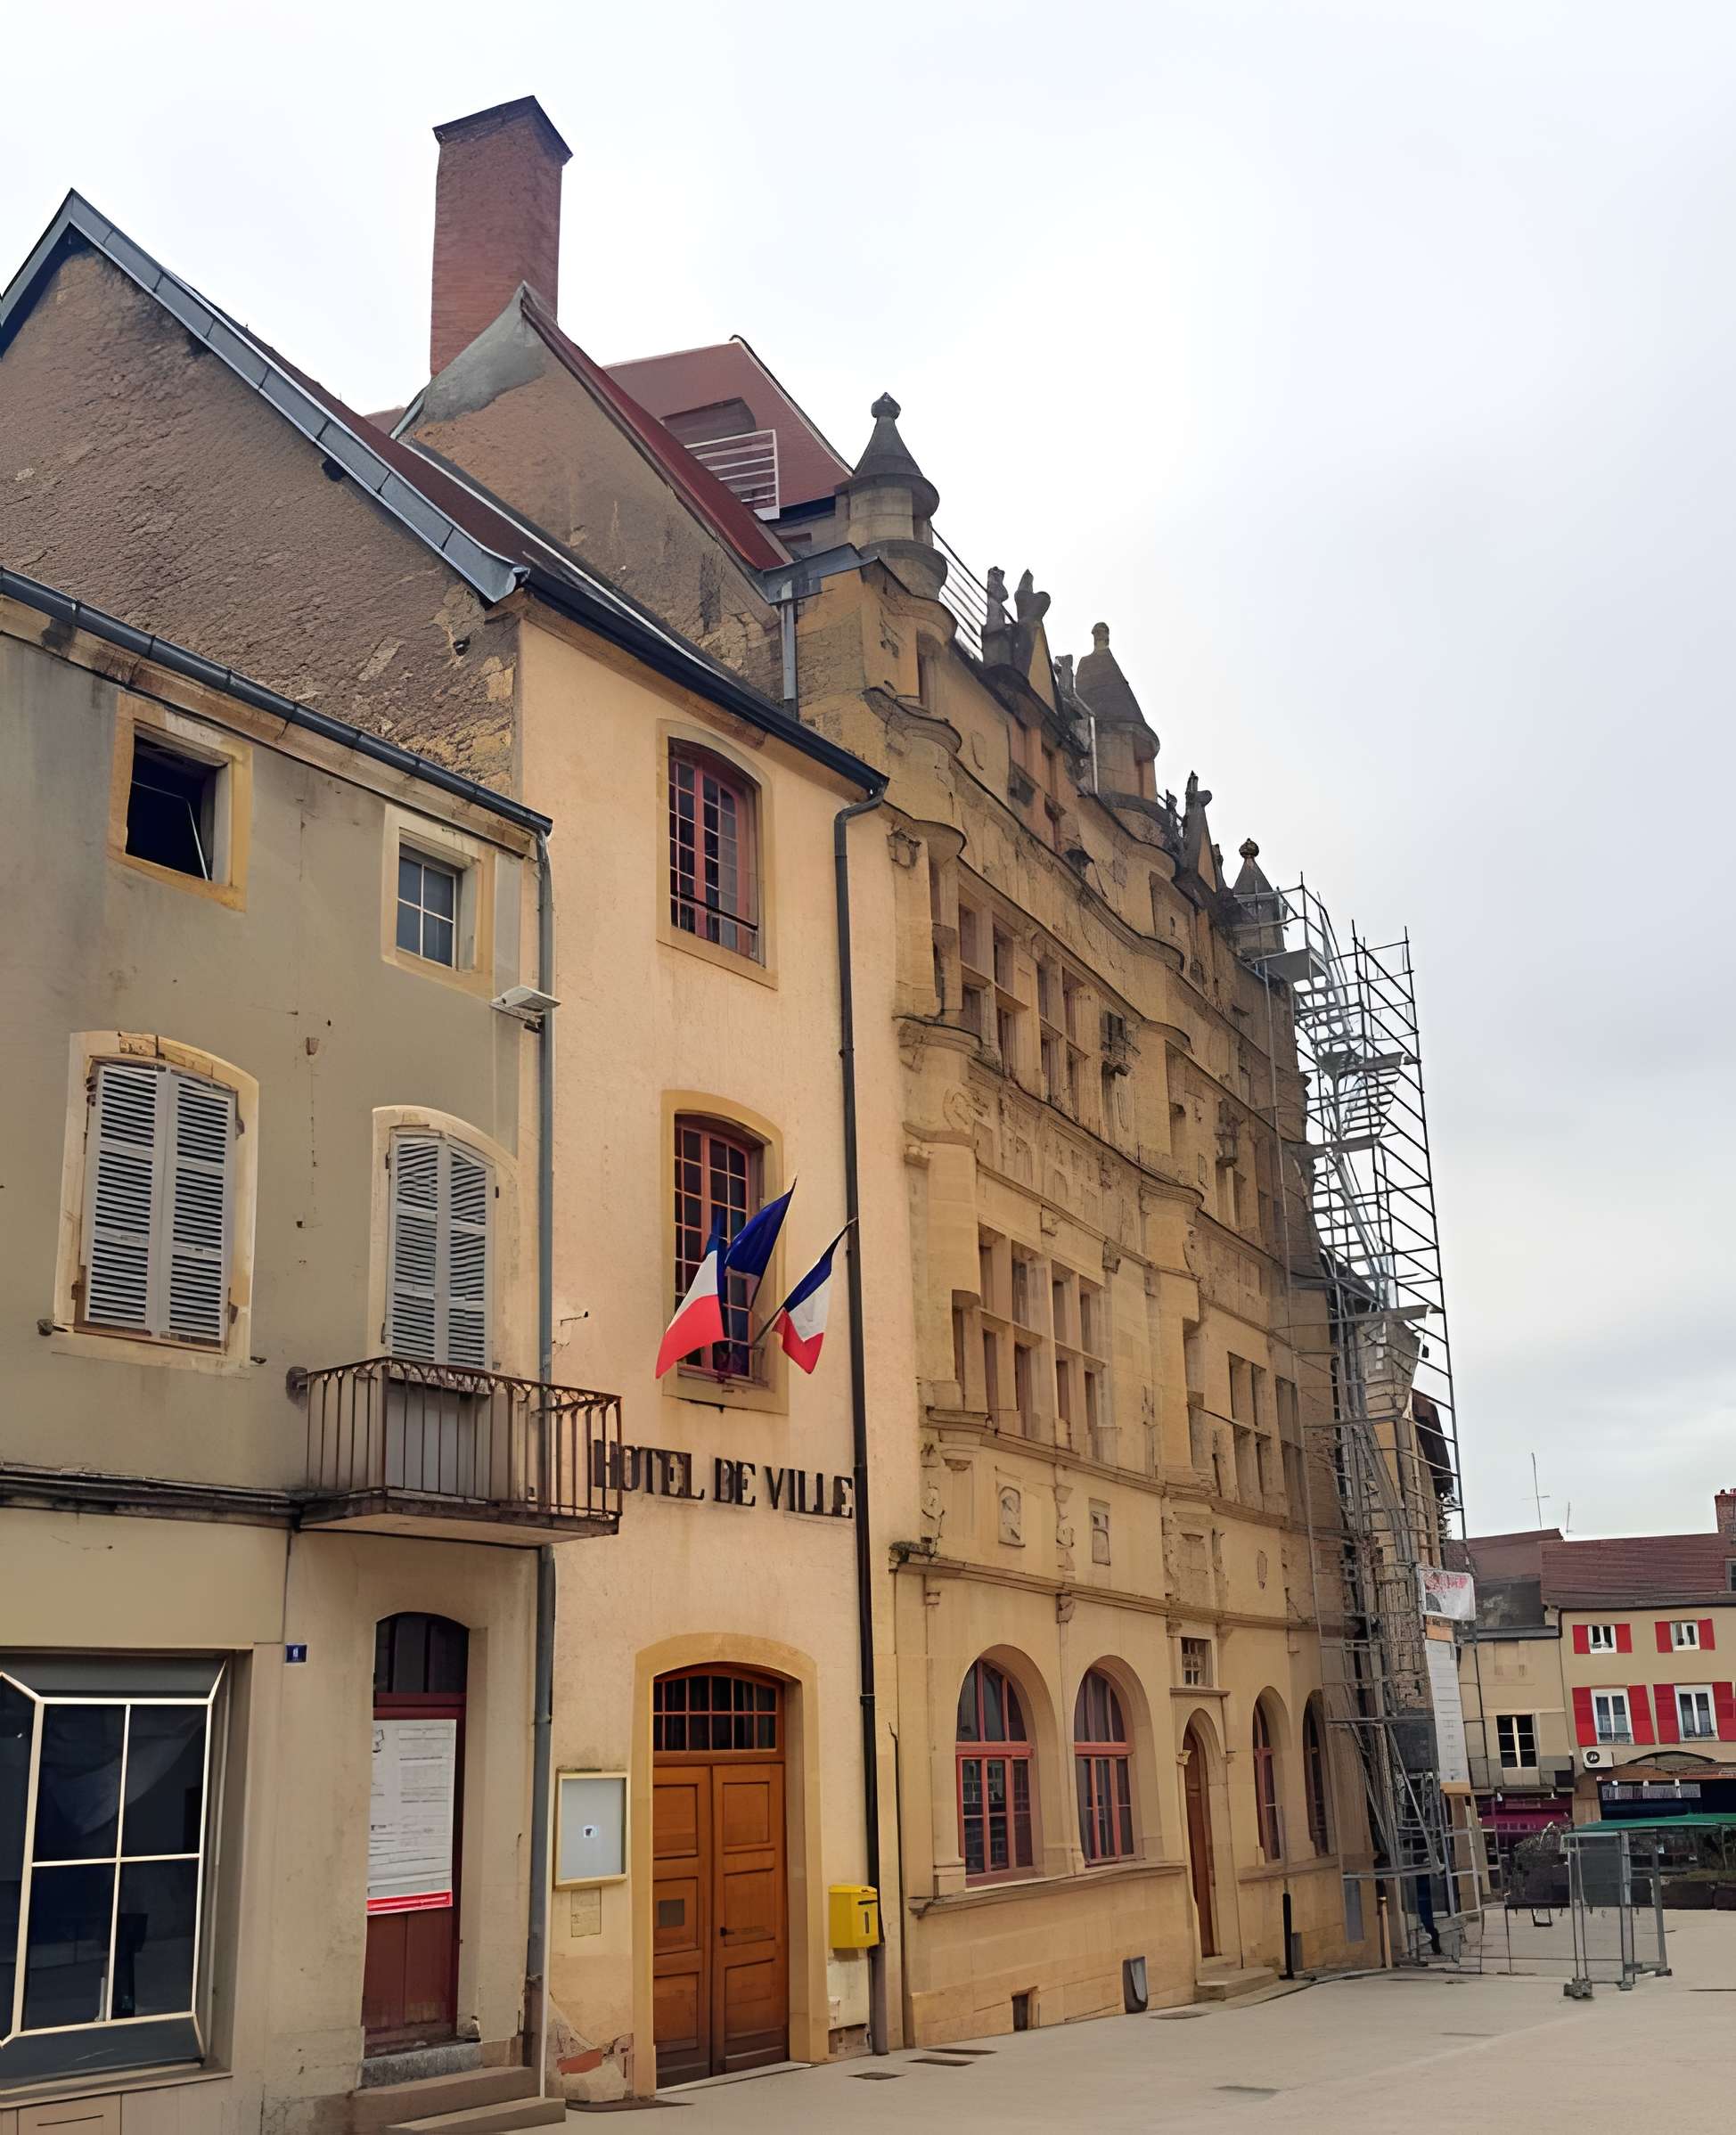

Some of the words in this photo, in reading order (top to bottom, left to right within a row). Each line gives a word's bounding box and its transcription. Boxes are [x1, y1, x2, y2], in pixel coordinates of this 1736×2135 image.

[594, 1439, 705, 1500] HOTEL
[713, 1458, 756, 1507] DE
[763, 1466, 853, 1519] VILLE
